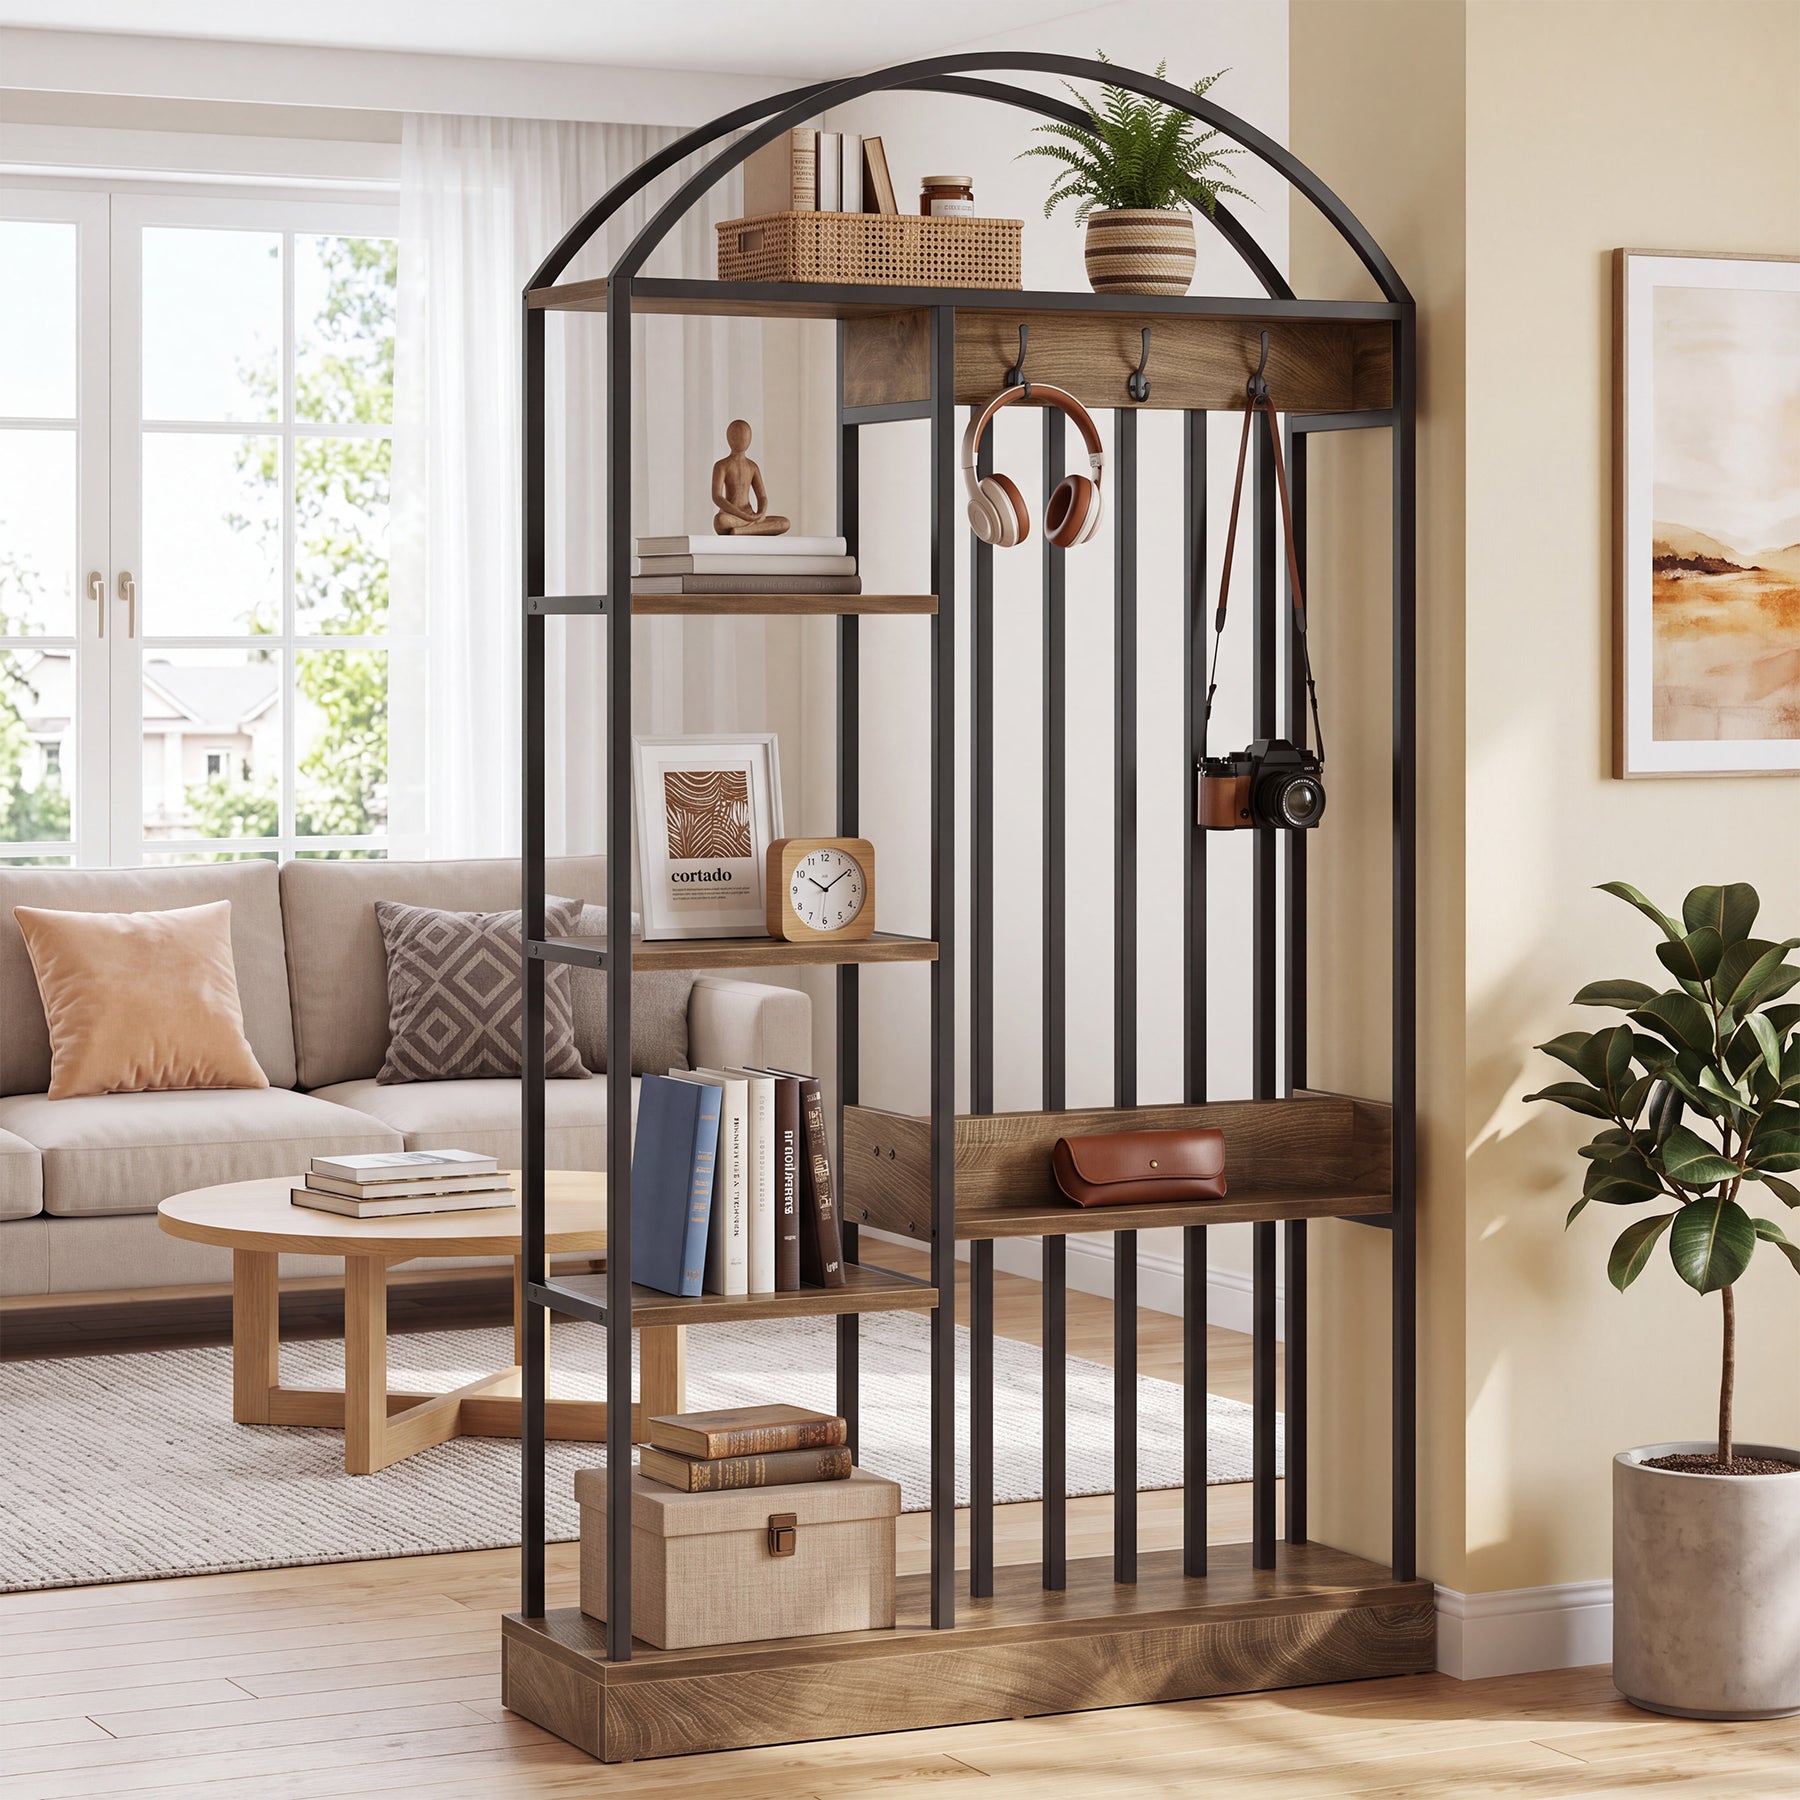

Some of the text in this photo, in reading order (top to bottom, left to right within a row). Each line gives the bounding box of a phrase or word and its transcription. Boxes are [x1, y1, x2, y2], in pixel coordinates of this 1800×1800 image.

[807, 858, 815, 866] 11
[820, 853, 830, 862] 12
[671, 867, 732, 882] cortado
[796, 870, 806, 879] 10
[846, 868, 852, 877] 2
[792, 886, 798, 895] 9
[851, 884, 857, 893] 3
[797, 902, 803, 911] 8
[847, 900, 853, 908] 4
[808, 912, 814, 920] 7
[837, 911, 843, 920] 5
[822, 917, 828, 925] 6
